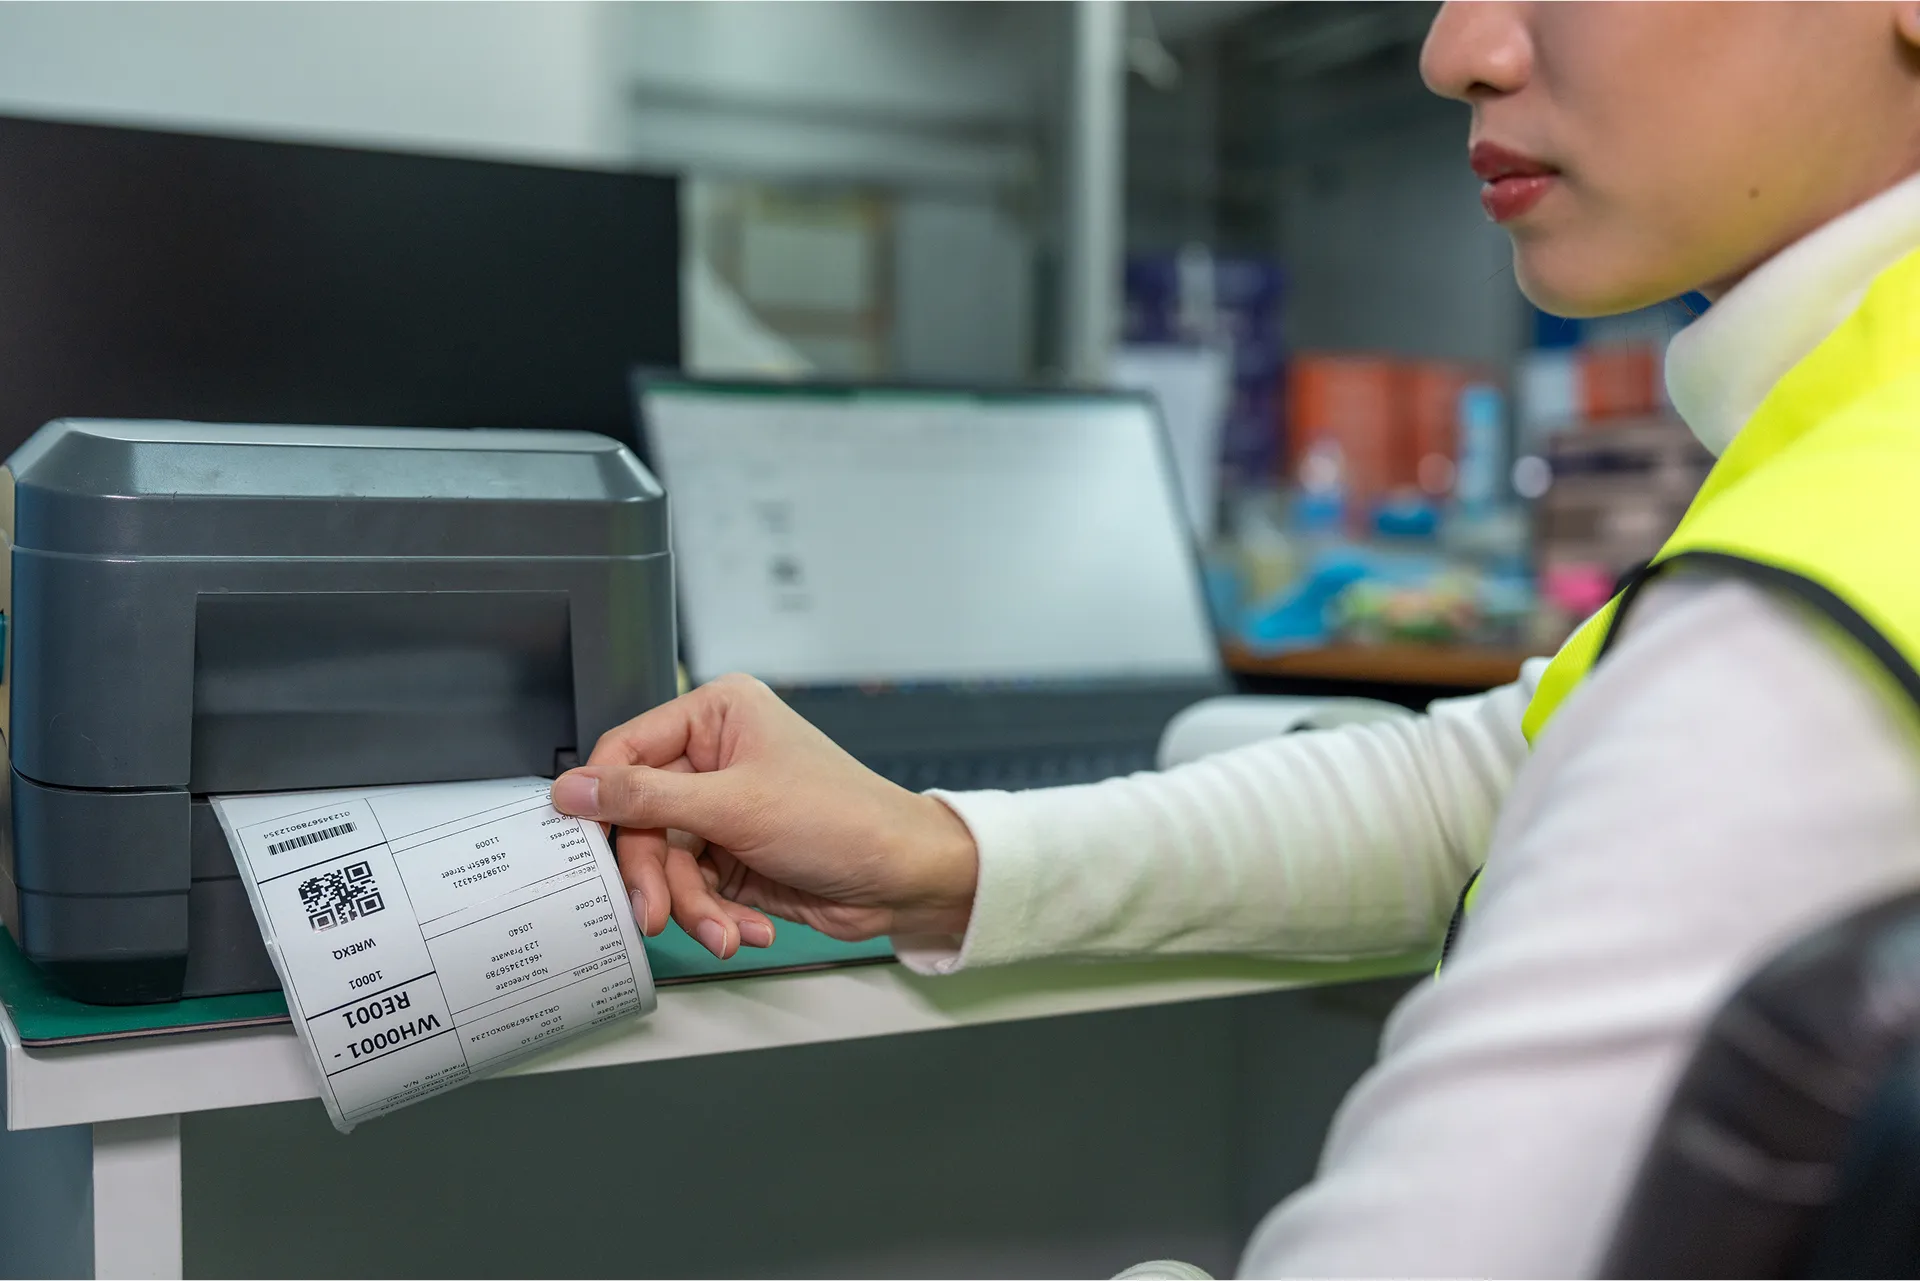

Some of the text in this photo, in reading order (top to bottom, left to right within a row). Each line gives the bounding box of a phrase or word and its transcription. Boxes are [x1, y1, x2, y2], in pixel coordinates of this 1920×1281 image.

[263, 811, 351, 839] 0123456789012354
[541, 817, 561, 827] Code
[549, 826, 580, 841] Address
[475, 836, 500, 850] 11009
[560, 836, 586, 849] Phone
[567, 850, 591, 863] Name
[441, 852, 506, 879] 456 865th Street
[452, 864, 510, 889] +01987654321
[575, 894, 609, 911] Zip Code
[583, 912, 613, 928] Address
[508, 922, 533, 938] 10540
[593, 924, 618, 938] Phone
[331, 938, 377, 960] WREXQ
[490, 940, 539, 963] 123 Prawate
[599, 939, 623, 952] Name
[485, 953, 542, 980] +66123456789
[531, 967, 549, 977] Nop
[572, 952, 627, 977] Sender Details
[348, 970, 383, 990] 10001
[611, 977, 633, 990] Order
[609, 988, 636, 1001] Weight
[342, 991, 411, 1029] RE001
[597, 997, 638, 1015] Order Date
[471, 1005, 560, 1043] OR1234567890XD1234
[347, 1014, 441, 1059] WH0001
[424, 1071, 441, 1080] Info
[403, 1080, 419, 1089] N/A
